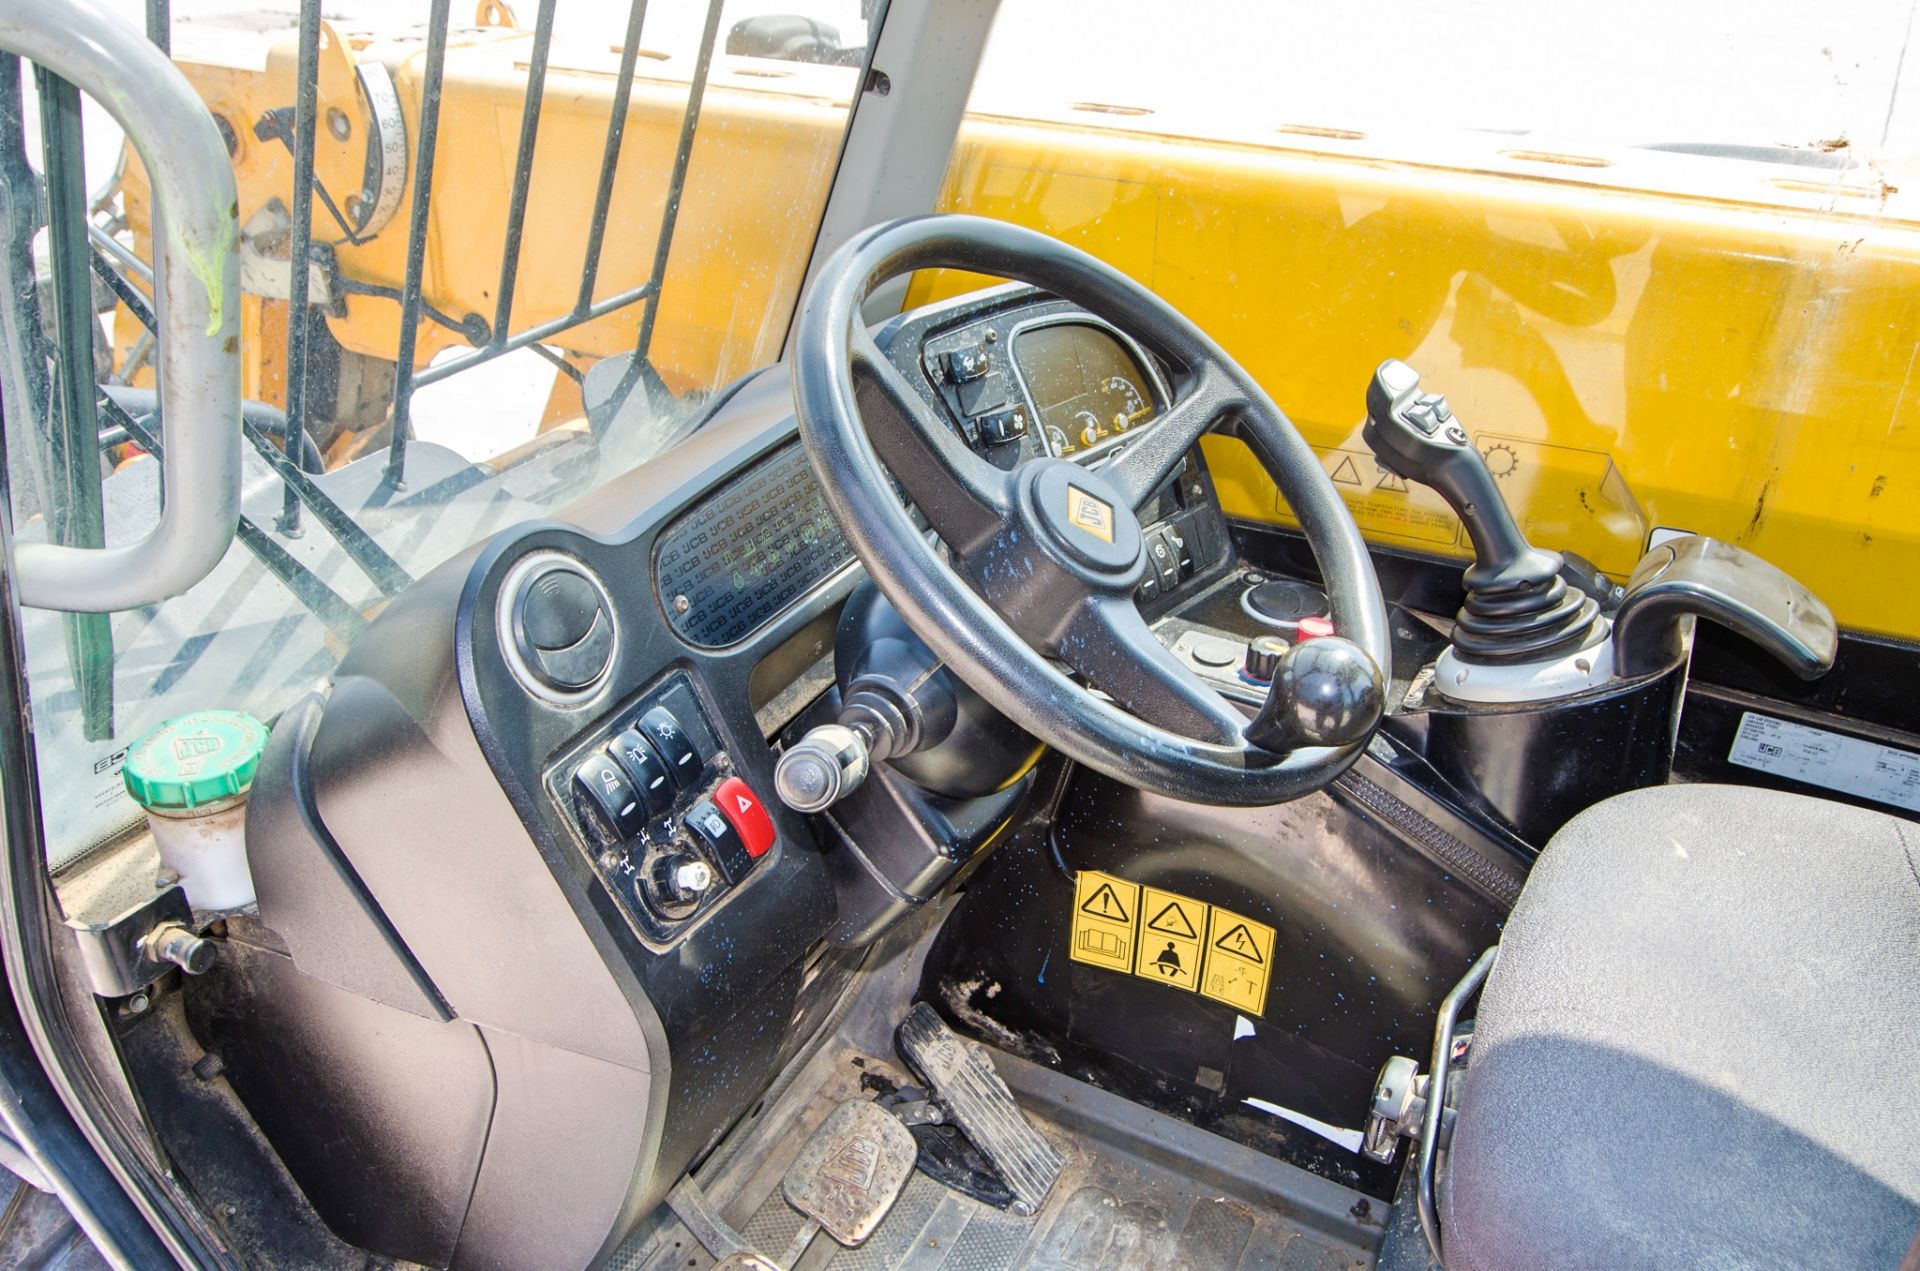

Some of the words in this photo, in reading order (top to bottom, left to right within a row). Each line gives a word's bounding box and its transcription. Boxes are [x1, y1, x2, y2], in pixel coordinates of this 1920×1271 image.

[375, 92, 389, 103] 70
[382, 117, 396, 130] 60
[385, 142, 399, 154] 50
[385, 165, 399, 177] 40
[792, 452, 808, 468] JC
[659, 549, 681, 569] CB
[682, 532, 708, 554] JCB
[709, 515, 735, 536] JCB
[736, 499, 761, 520] JCB
[761, 484, 785, 503] JCB
[786, 469, 809, 488] JCB
[1079, 499, 1103, 526] JCB
[674, 555, 701, 578] JCB
[702, 538, 728, 560] JCB
[729, 521, 754, 542] JCB
[755, 505, 779, 526] JCB
[780, 490, 802, 510] JCB
[803, 480, 820, 496] JC
[694, 561, 722, 584] JCB
[701, 614, 728, 638] JCB
[728, 596, 754, 619] JCB
[754, 579, 779, 600] JCB
[779, 562, 803, 583] JCB
[803, 545, 826, 566] JCB
[721, 619, 748, 643] JCB
[747, 601, 773, 624] JCB
[773, 584, 797, 605] JCB
[797, 567, 821, 588] JCB
[820, 551, 843, 571] JCB
[681, 609, 708, 633] JCB
[708, 591, 734, 614] JCB
[179, 739, 219, 759] JCB
[1758, 743, 1783, 757] JCB
[824, 1140, 874, 1187] JCB
